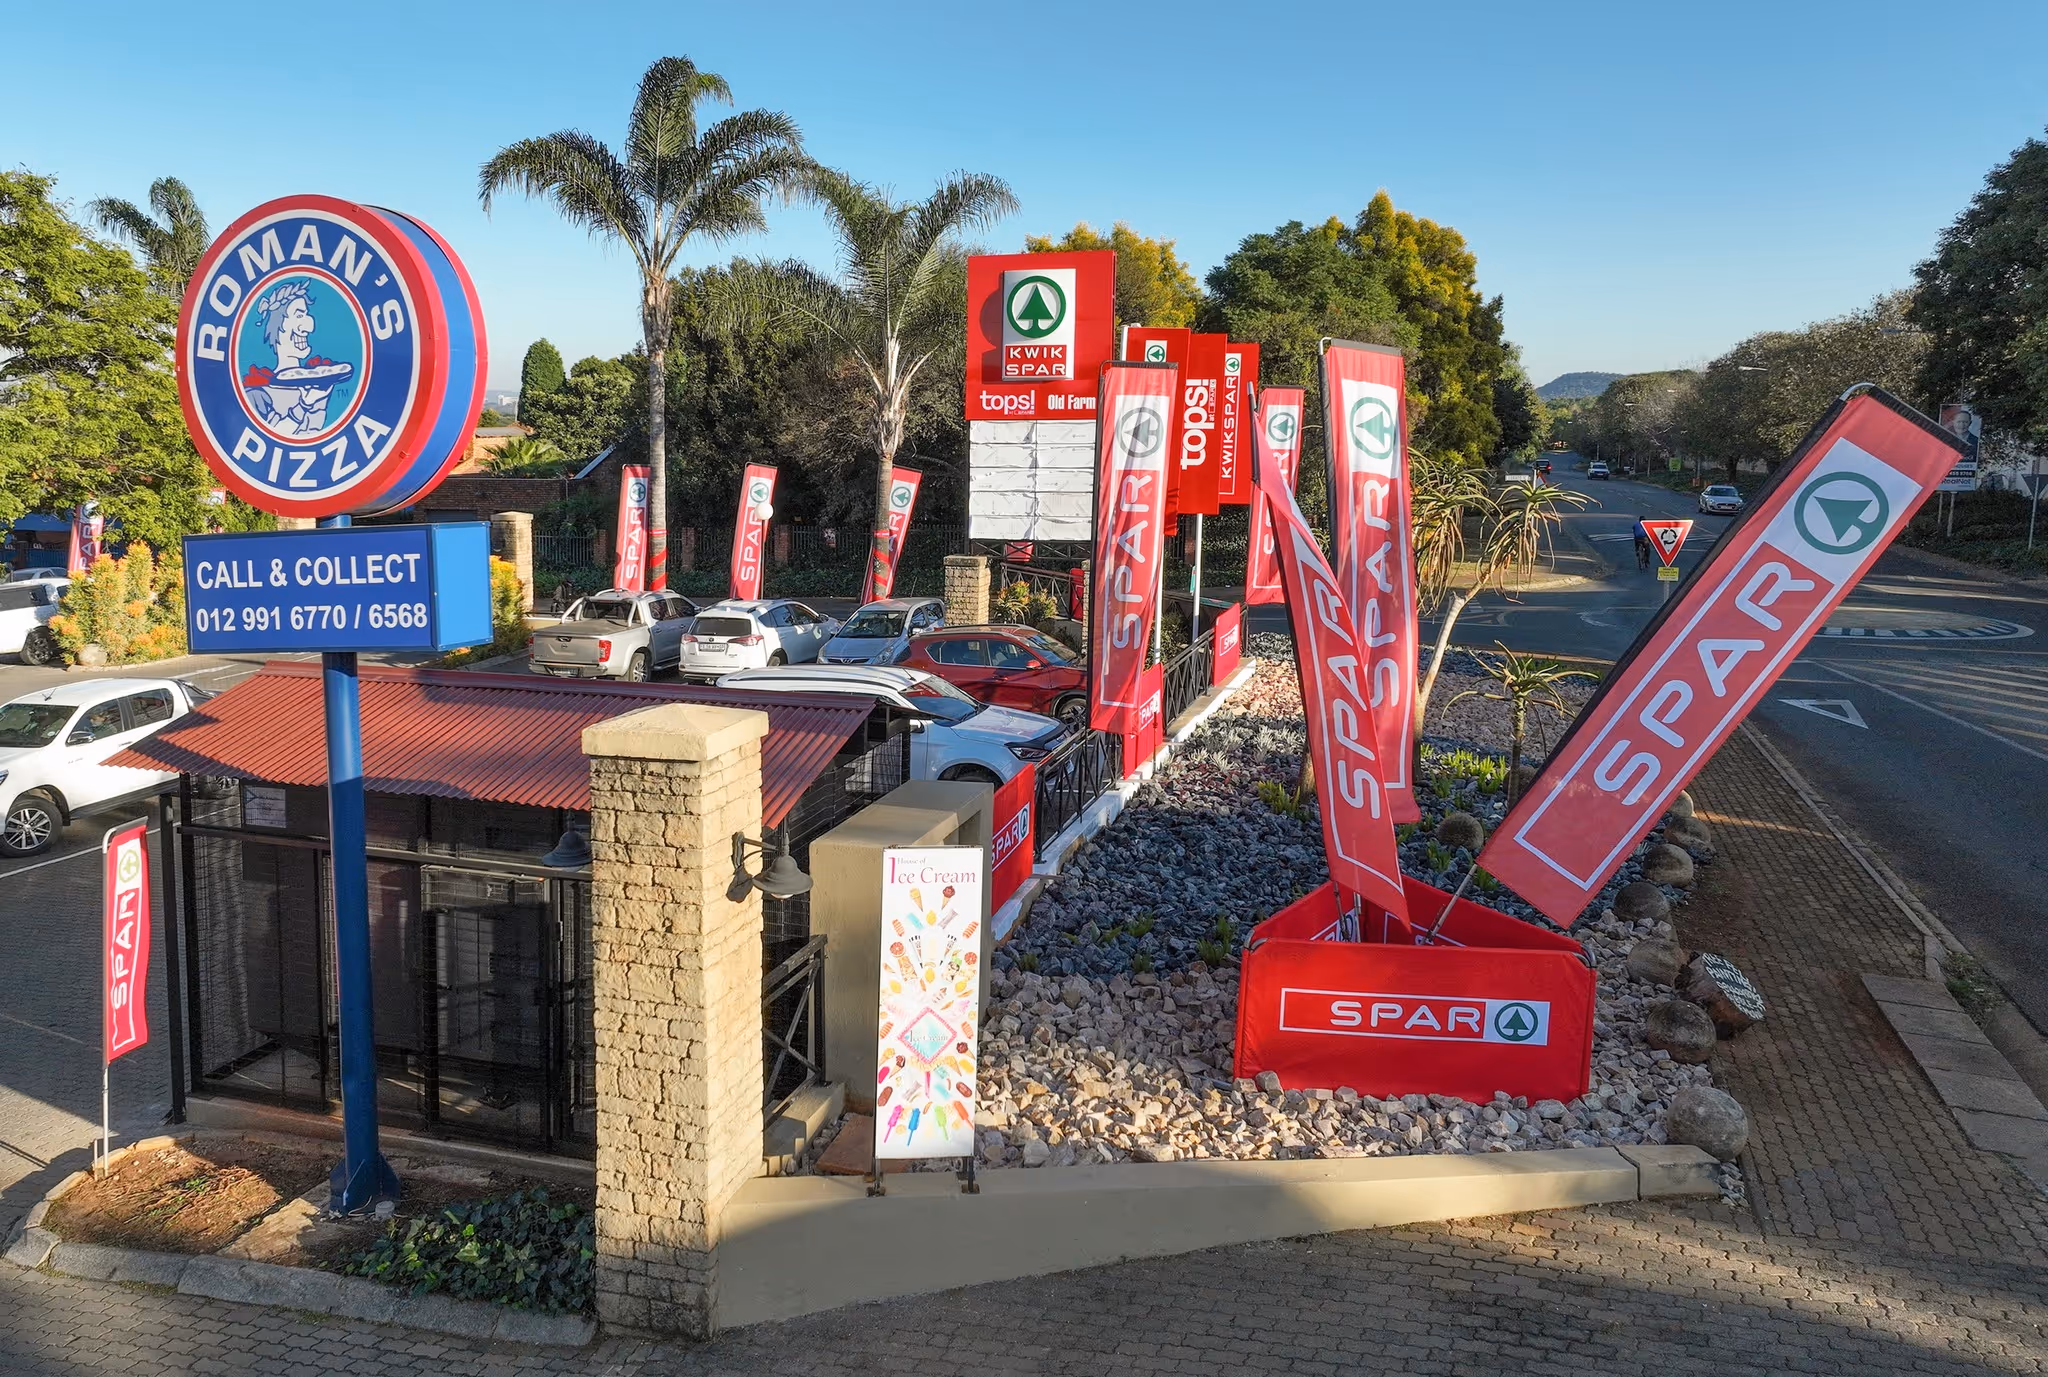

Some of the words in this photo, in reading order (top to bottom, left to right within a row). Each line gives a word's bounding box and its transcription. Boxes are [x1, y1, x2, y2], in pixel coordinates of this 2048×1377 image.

[197, 225, 405, 362] ROMAN'S
[1006, 364, 1065, 375] SPAR
[1010, 347, 1063, 359] KWIK
[980, 390, 1035, 414] tops!
[1048, 395, 1064, 409] Old
[1068, 395, 1096, 409] Farm
[1180, 379, 1215, 470] tops!
[232, 414, 391, 488] PIZZA
[196, 560, 263, 590] CALL
[269, 558, 288, 587] &
[294, 553, 421, 586] COLLECT
[625, 508, 642, 580] SPAR
[1113, 474, 1152, 649] SPAR
[196, 607, 236, 632] 012
[242, 606, 281, 631] 991
[290, 604, 347, 630] 6770
[354, 604, 362, 629] /
[368, 602, 428, 629] 6568
[1364, 479, 1399, 709] SPAR
[1313, 579, 1380, 819] SPAR
[1593, 562, 1814, 807] SPAR
[888, 857, 915, 884] Ice
[920, 867, 976, 884] Cream
[114, 889, 135, 1009] SPAR
[1330, 1000, 1480, 1033] SPAR
